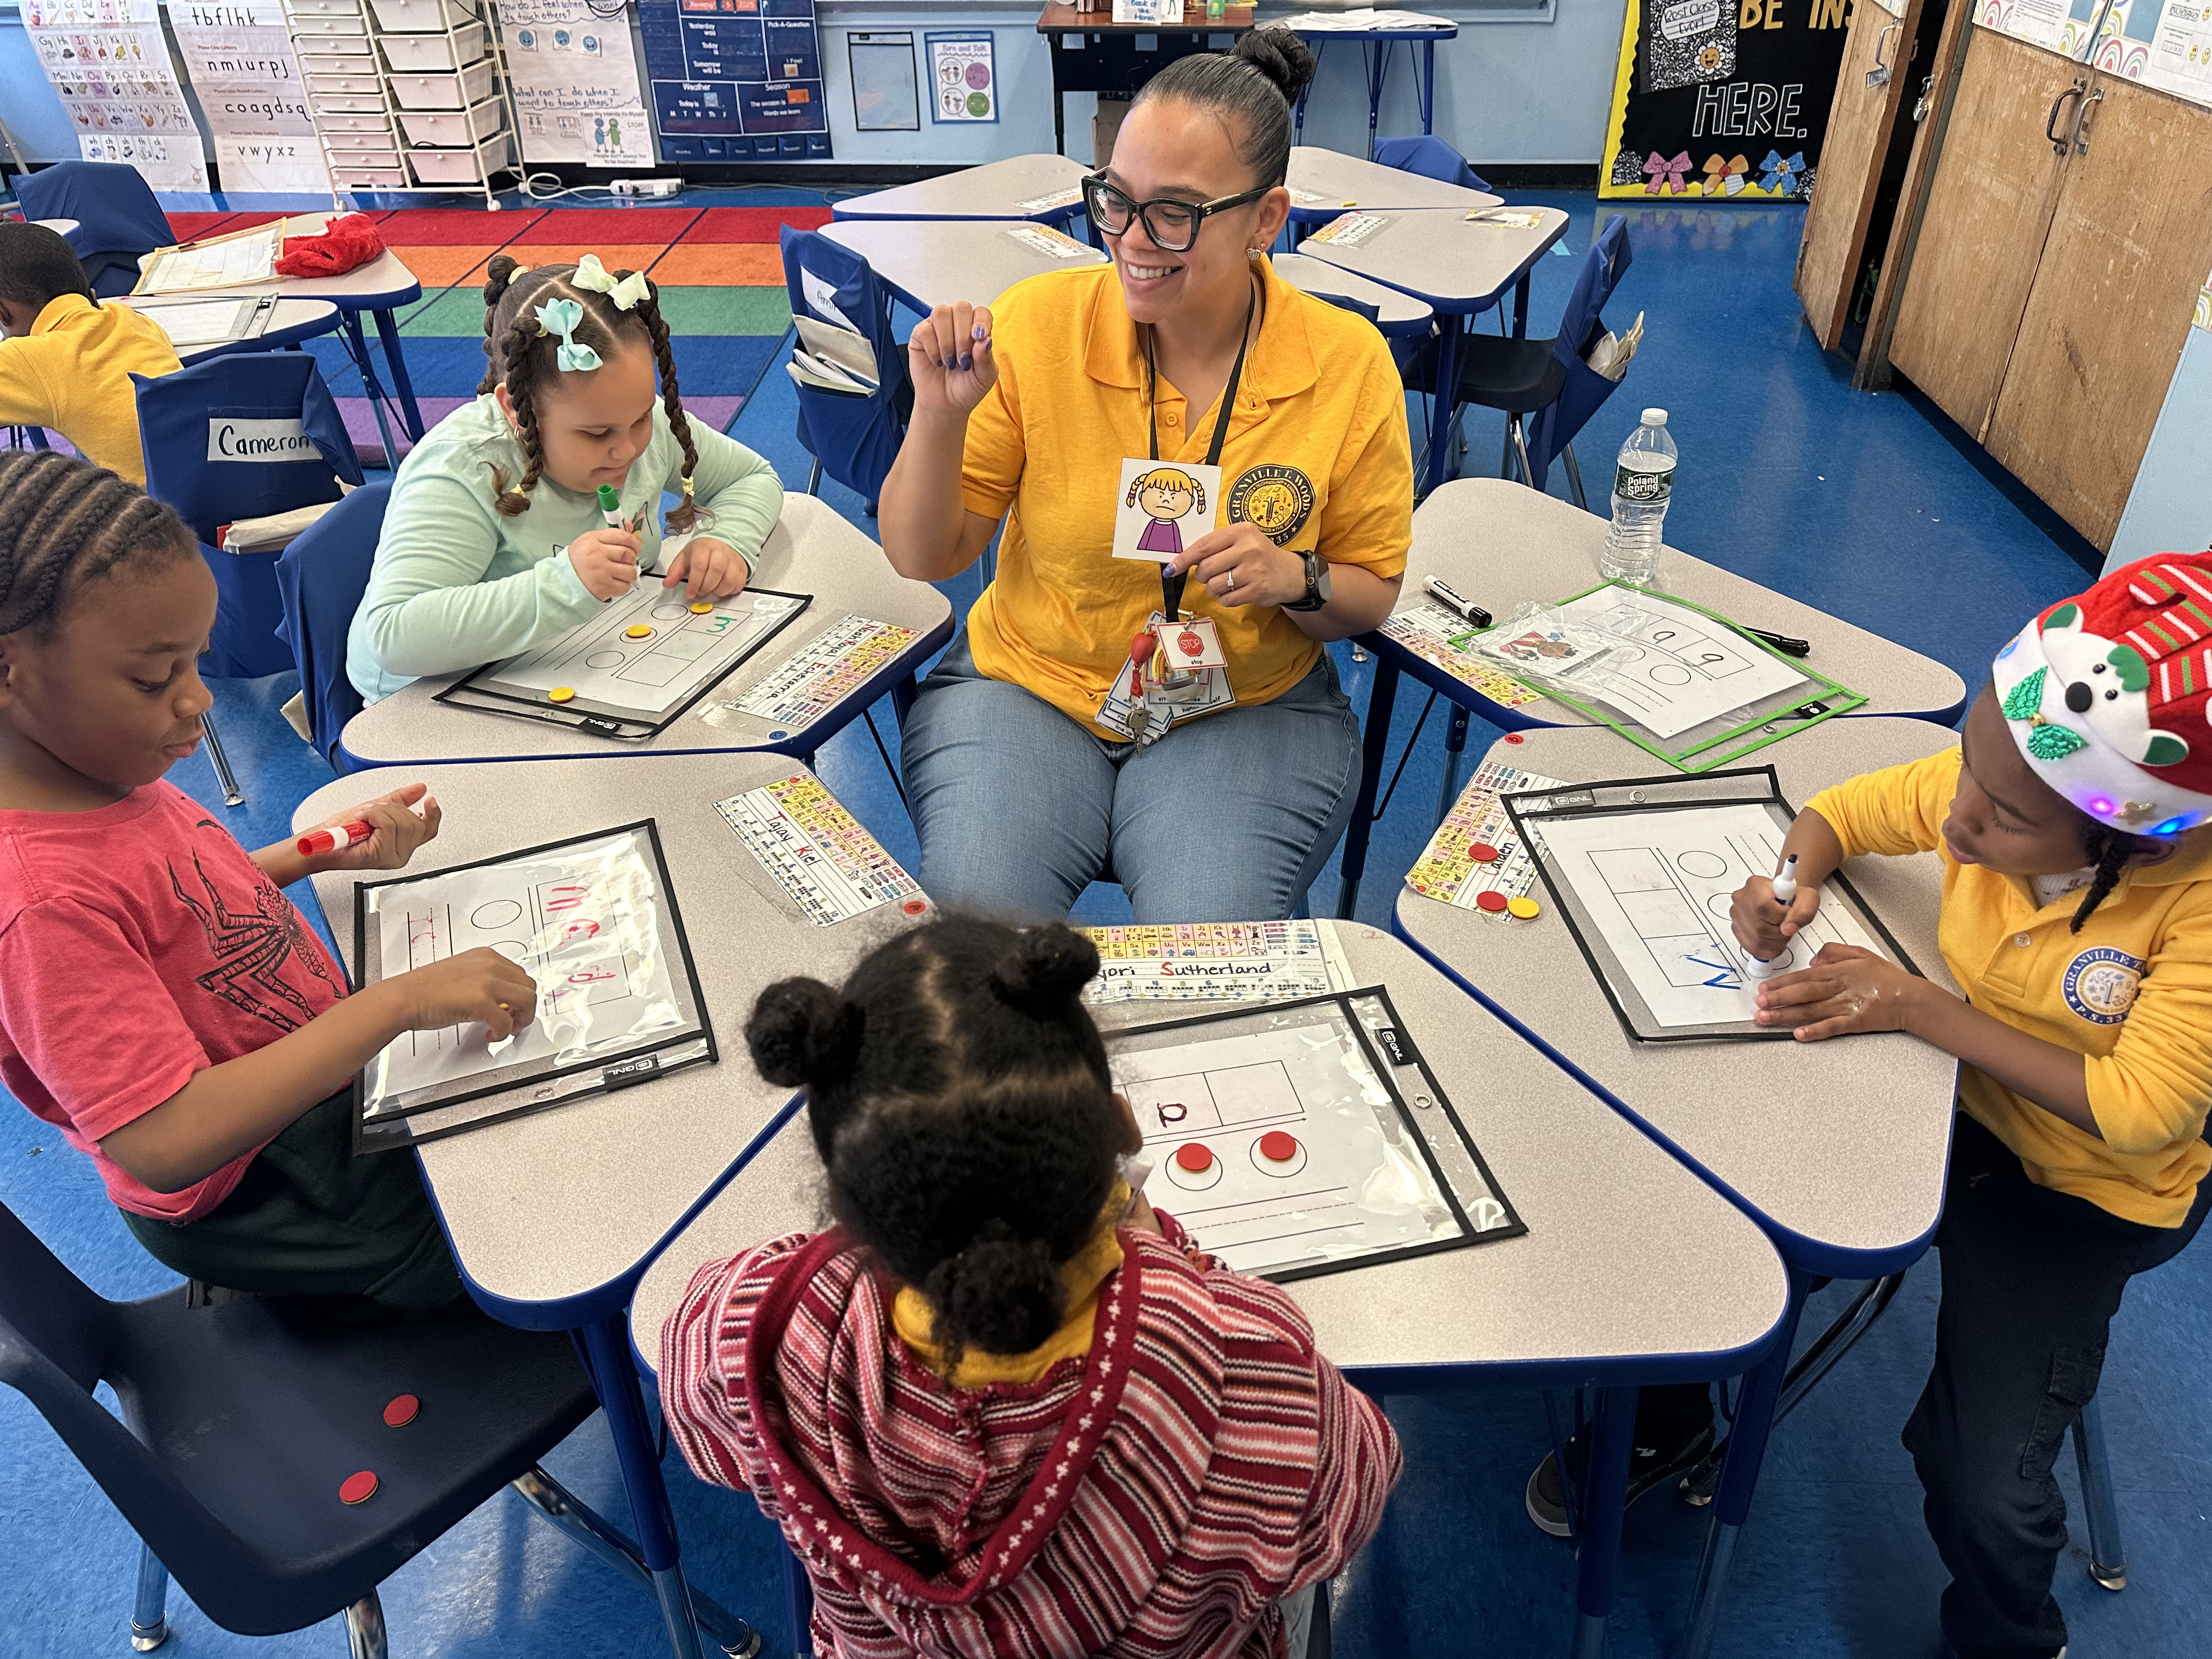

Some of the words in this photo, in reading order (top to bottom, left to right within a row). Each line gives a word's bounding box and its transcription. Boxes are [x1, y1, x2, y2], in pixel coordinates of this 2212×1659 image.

[505, 12, 515, 21] to
[517, 12, 540, 20] touch
[1664, 6, 1688, 23] Best
[1690, 2, 1717, 15] Class
[1739, 0, 1783, 30] BE
[1679, 15, 1705, 33] Ever!
[512, 86, 534, 97] What
[682, 83, 711, 91] Weather
[765, 83, 791, 91] Season
[678, 100, 694, 108] Today
[1692, 82, 1807, 138] HERE.
[219, 425, 309, 456] Cameron
[1256, 480, 1285, 488] TECHNOLOGY
[1628, 475, 1658, 486] Poland
[1232, 468, 1282, 518] GRANVILLE
[1285, 470, 1293, 479] T.
[1294, 475, 1311, 519] WOODS
[1628, 483, 1658, 496] Spring
[1181, 639, 1199, 649] STOP
[1115, 724, 1125, 732] line
[1569, 794, 1592, 803] GNL
[766, 811, 794, 843] Tajay
[1160, 962, 1272, 976] Sutherland
[2066, 950, 2130, 992] GRANVILLE
[1389, 1042, 1403, 1061] GNL
[607, 1065, 636, 1076] GNL
